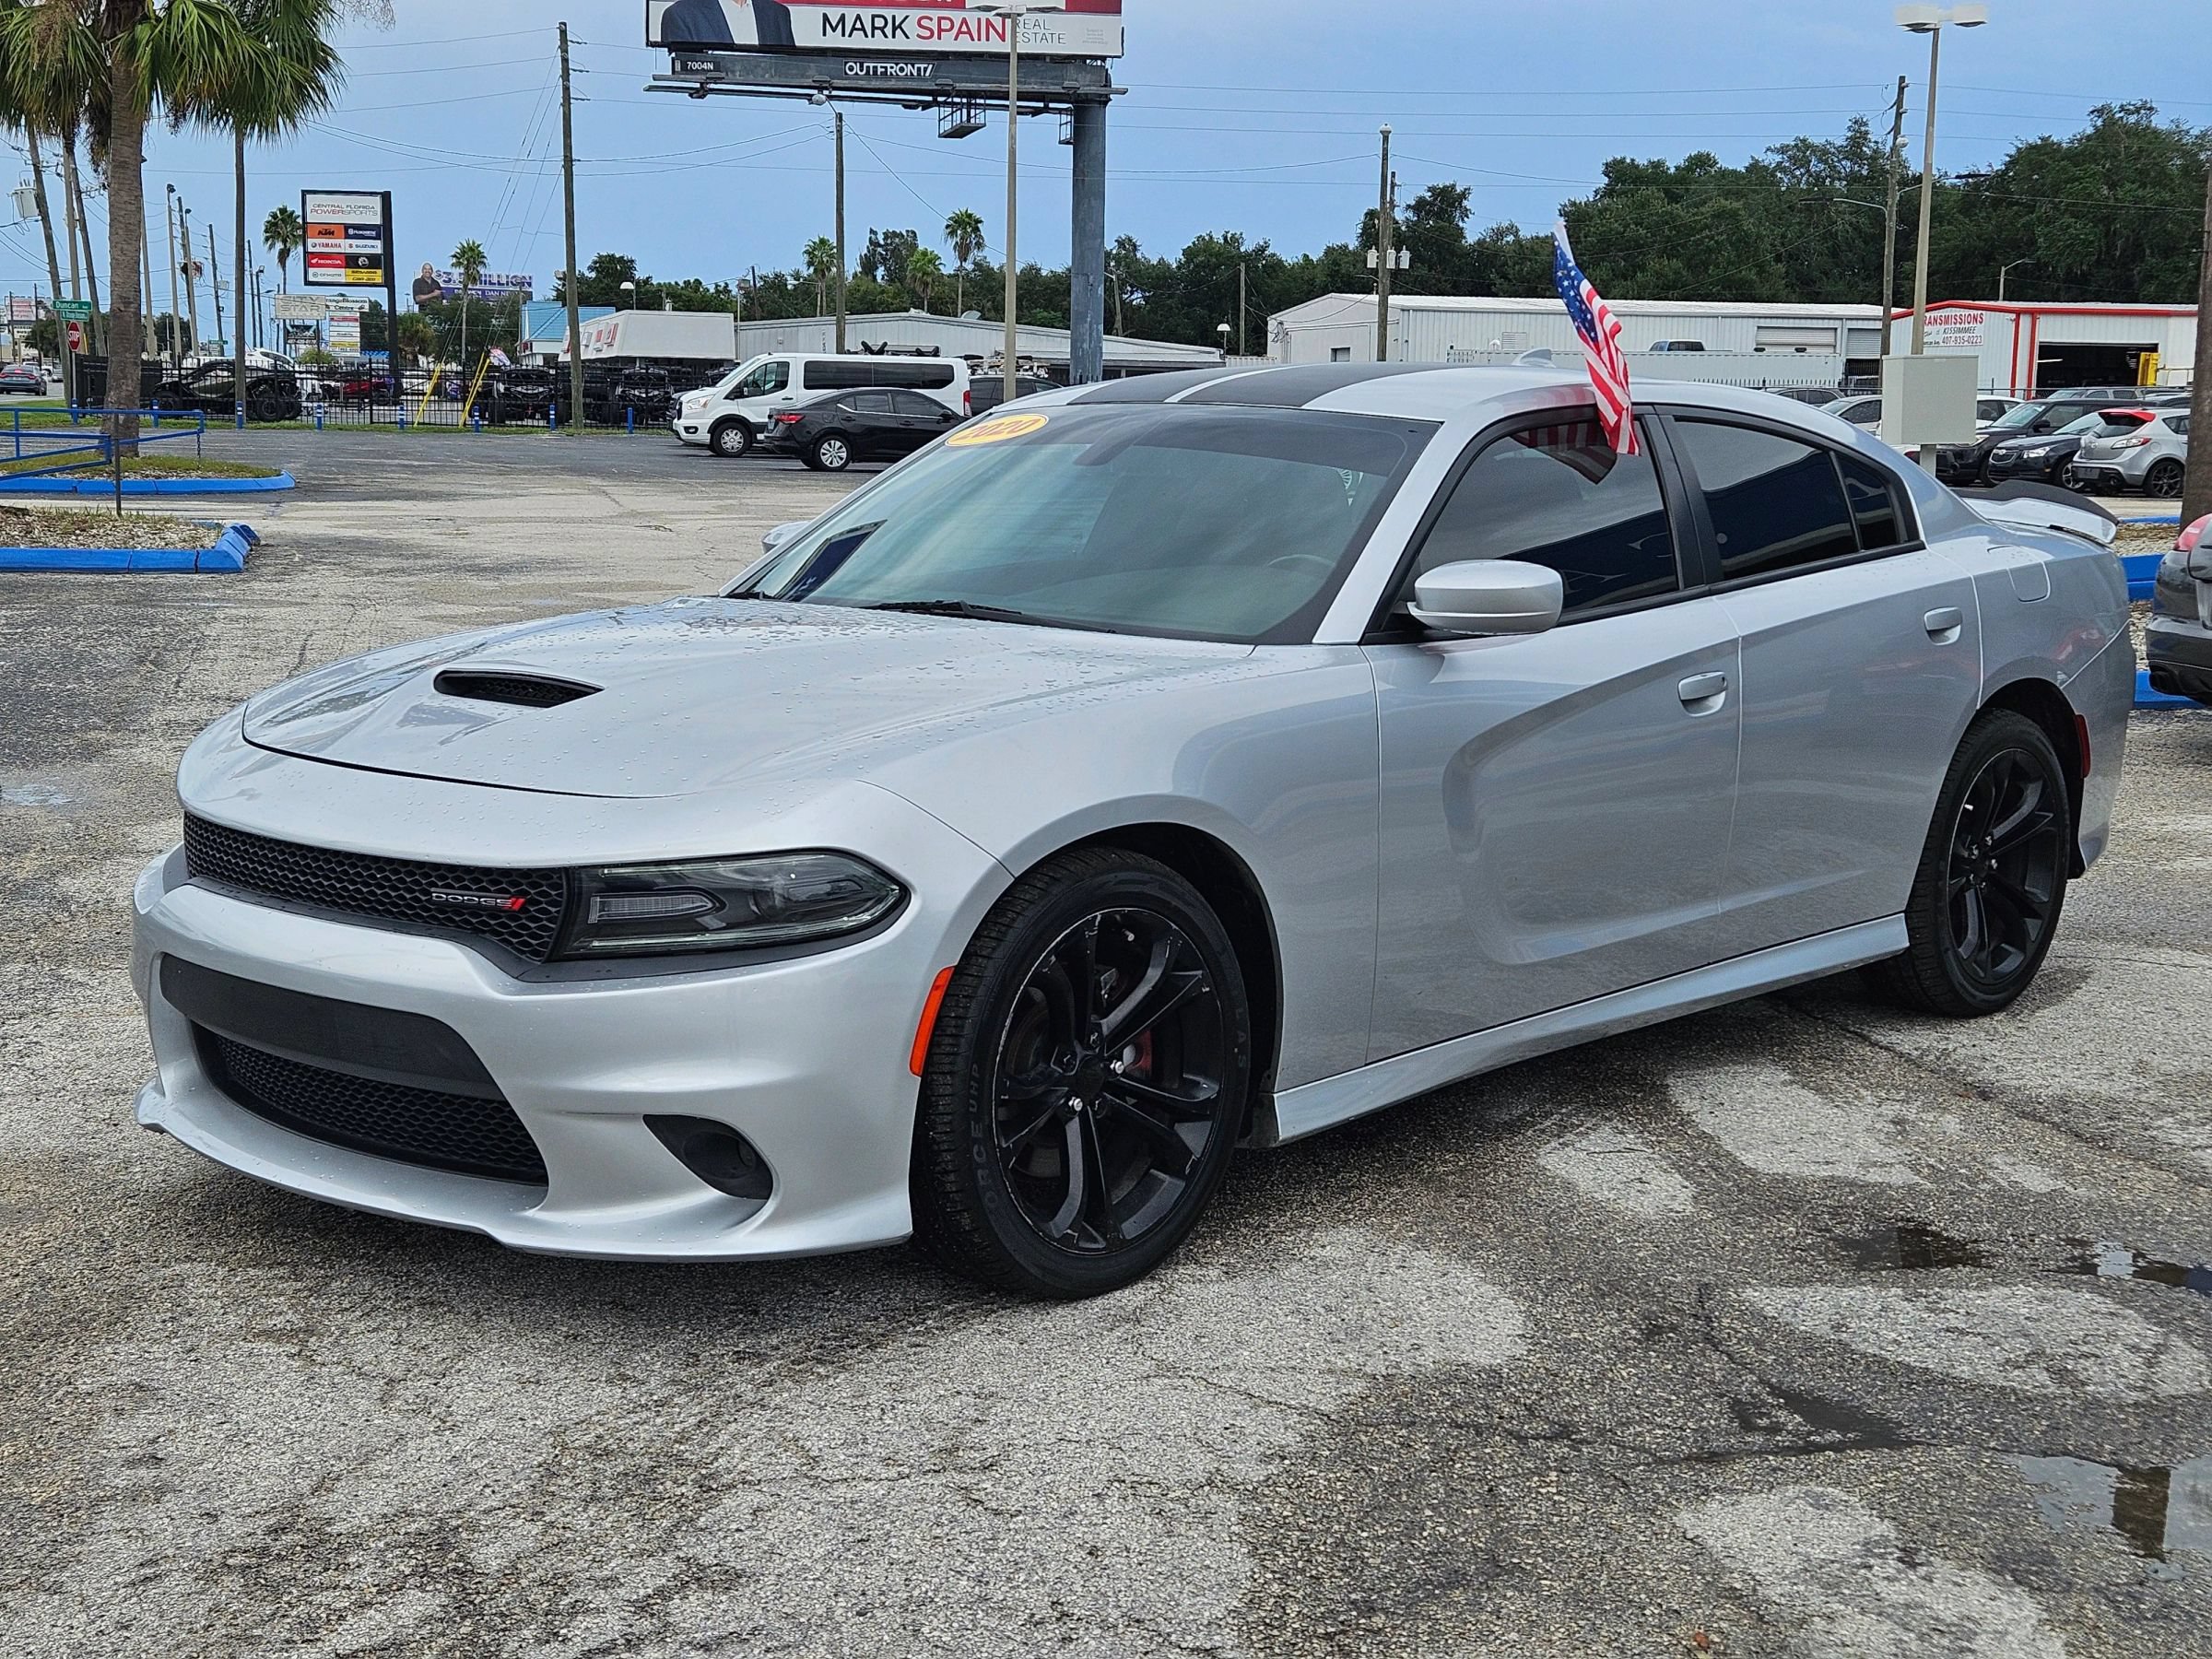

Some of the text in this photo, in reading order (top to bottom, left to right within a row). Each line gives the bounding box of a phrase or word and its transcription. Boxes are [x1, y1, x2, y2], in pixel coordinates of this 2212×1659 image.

[822, 12, 1006, 43] MARK SPAIN
[686, 61, 714, 70] 7004N
[310, 208, 378, 217] POWERSPORTS
[317, 228, 335, 236] KTM
[477, 273, 532, 288] ILLION
[55, 300, 79, 309] Duncan
[280, 304, 321, 312] STAR
[1924, 312, 1984, 326] RANSMISSIONS
[68, 331, 80, 342] STOP
[1941, 335, 1983, 345] 407-935-0223
[952, 418, 1041, 441] 2020
[431, 892, 512, 908] DODGE
